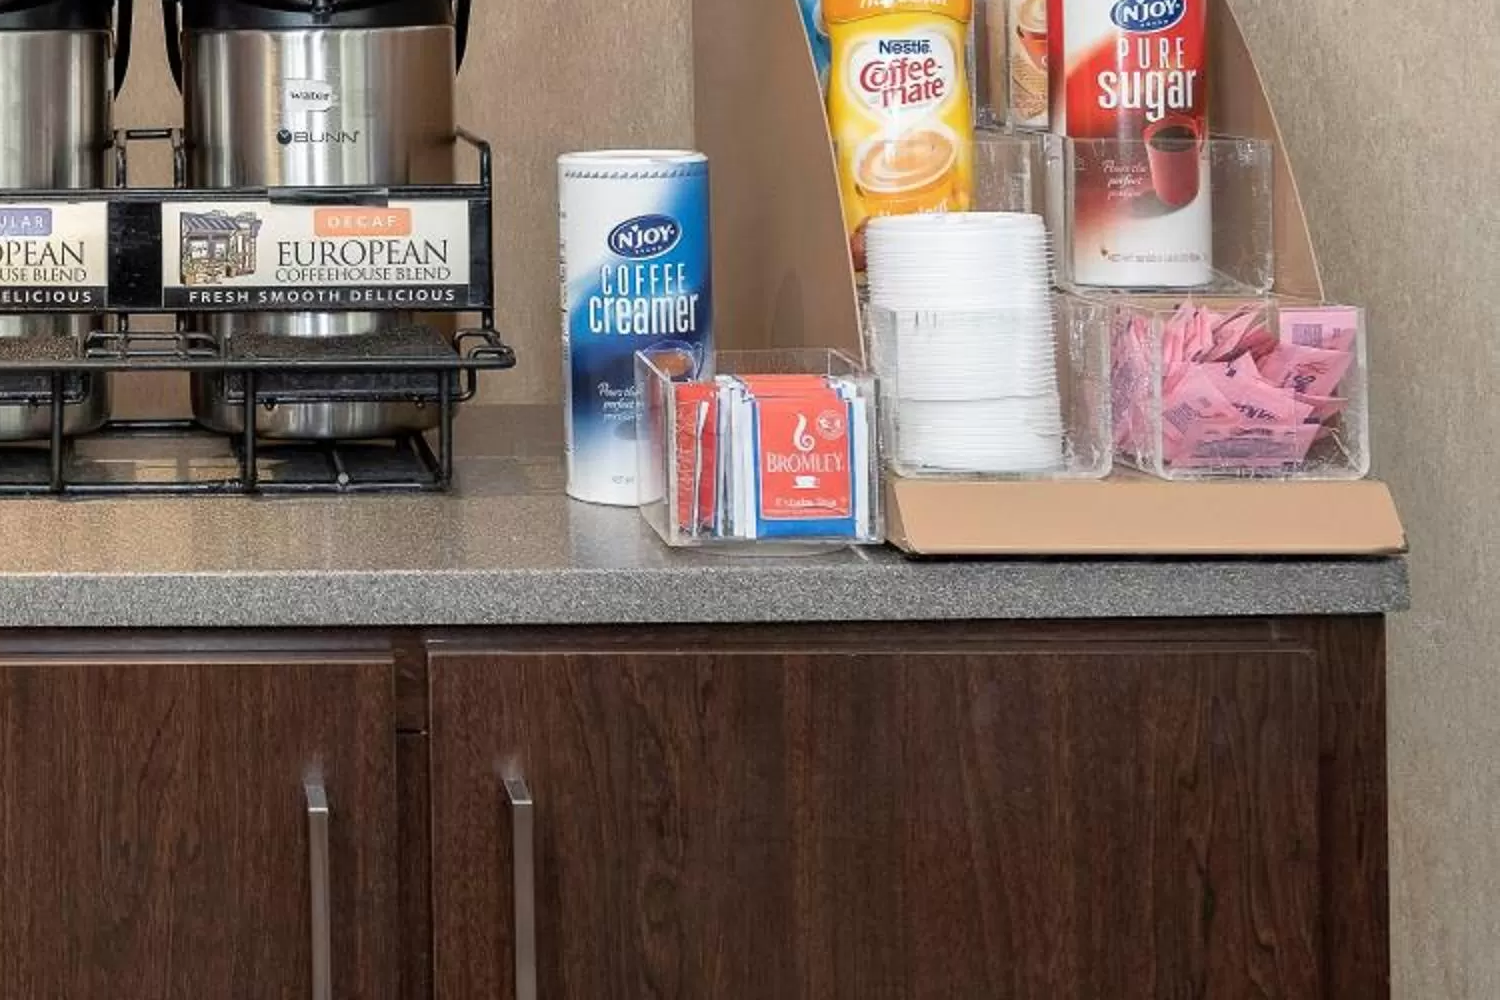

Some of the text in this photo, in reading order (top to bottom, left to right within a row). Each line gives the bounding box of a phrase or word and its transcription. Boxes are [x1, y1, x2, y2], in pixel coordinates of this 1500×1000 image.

[1117, 36, 1185, 69] PURE
[290, 90, 331, 101] water
[881, 77, 945, 108] mate
[1097, 69, 1197, 123] sugar
[294, 131, 358, 143] BUNN
[326, 215, 399, 228] DECAF
[276, 240, 448, 267] EUROPEAN
[32, 267, 88, 283] BLEND
[274, 265, 452, 283] COFFEEHOUSE BLEND
[601, 263, 686, 296] COFFEE
[188, 288, 456, 304] FRESH SMOOTH DELICIOUS
[588, 293, 699, 335] creamer
[766, 451, 844, 473] BROMLEY
